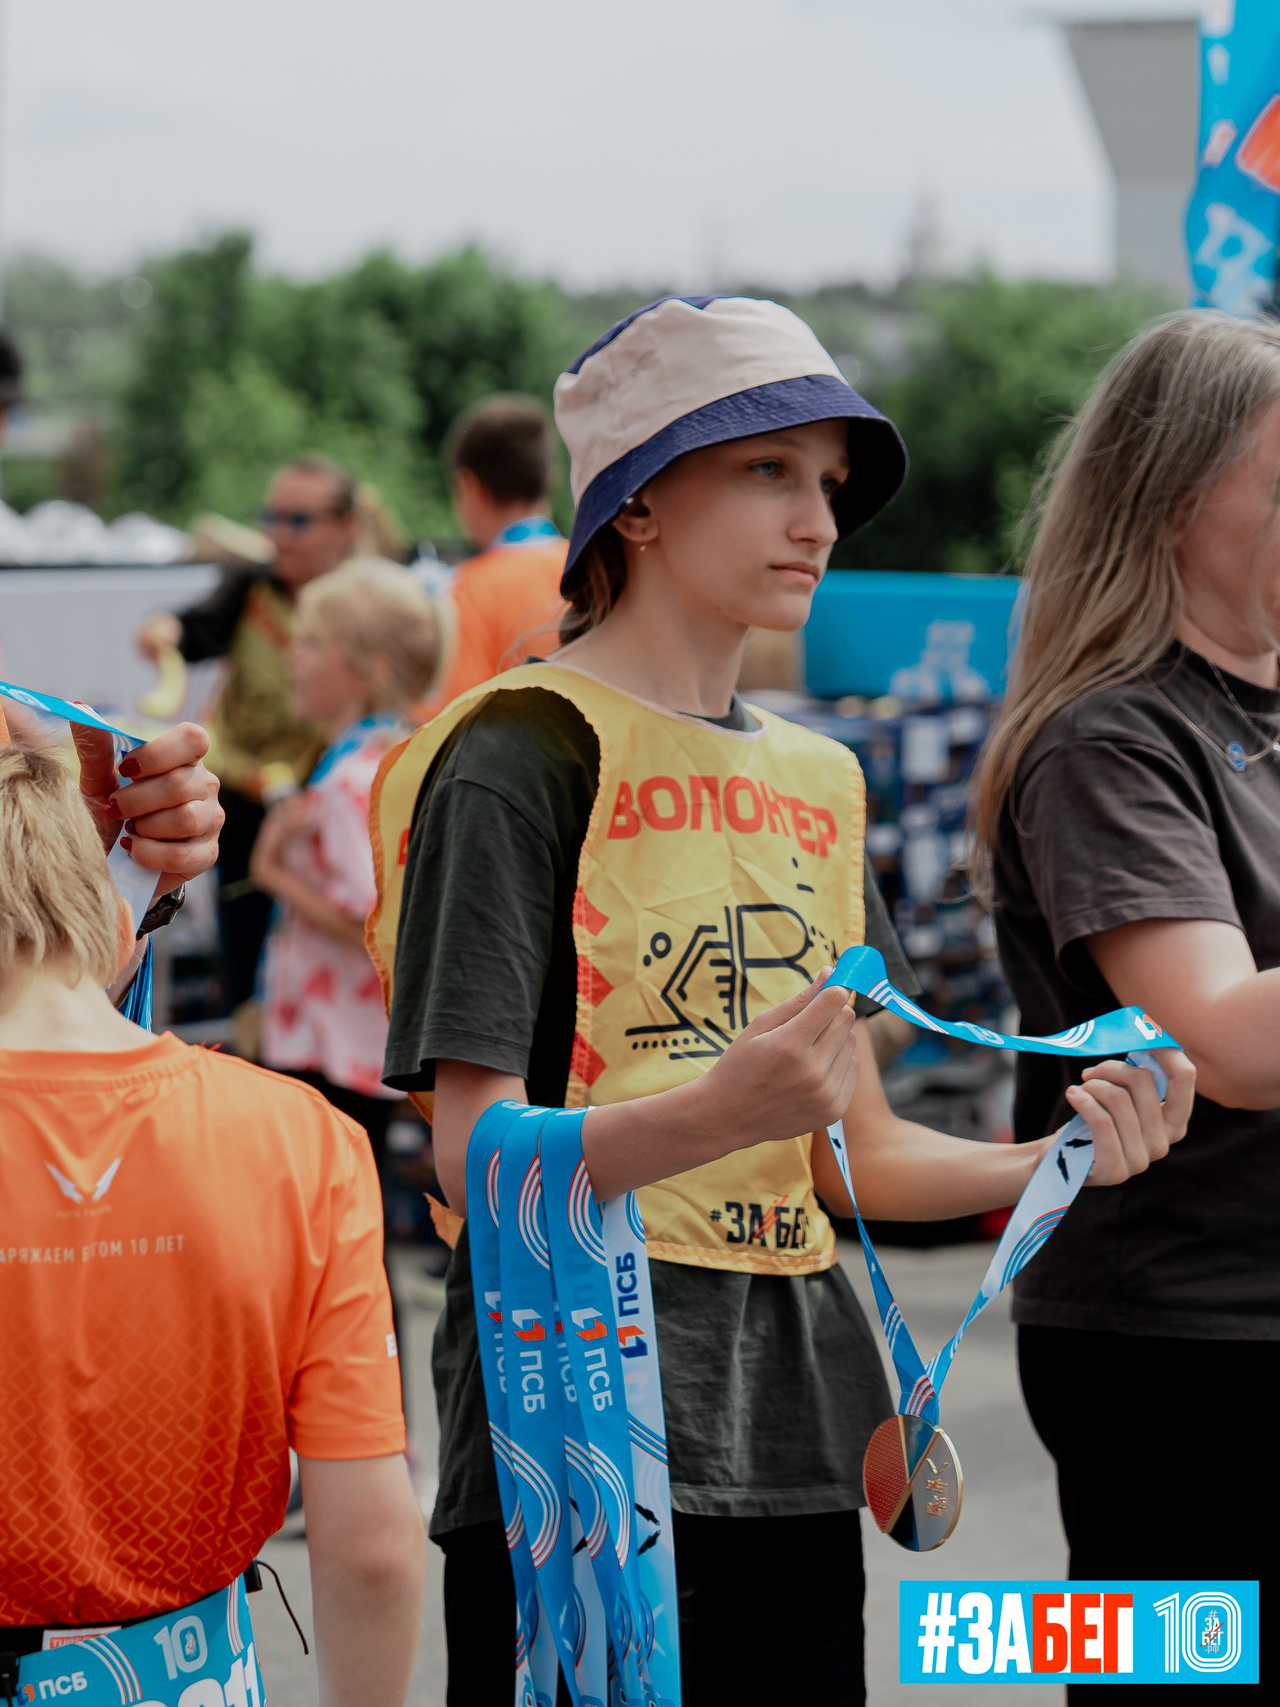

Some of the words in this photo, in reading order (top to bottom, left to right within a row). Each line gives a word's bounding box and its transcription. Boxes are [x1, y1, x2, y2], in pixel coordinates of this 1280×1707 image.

[130, 1238, 148, 1256] 10
[154, 1234, 185, 1254] ЛЕТ
[615, 1252, 640, 1318] ПСБ
[520, 1350, 546, 1413] ПСБ
[584, 1347, 613, 1412] ПСБ
[153, 1615, 208, 1680] 10
[39, 1671, 88, 1699] ПСБ
